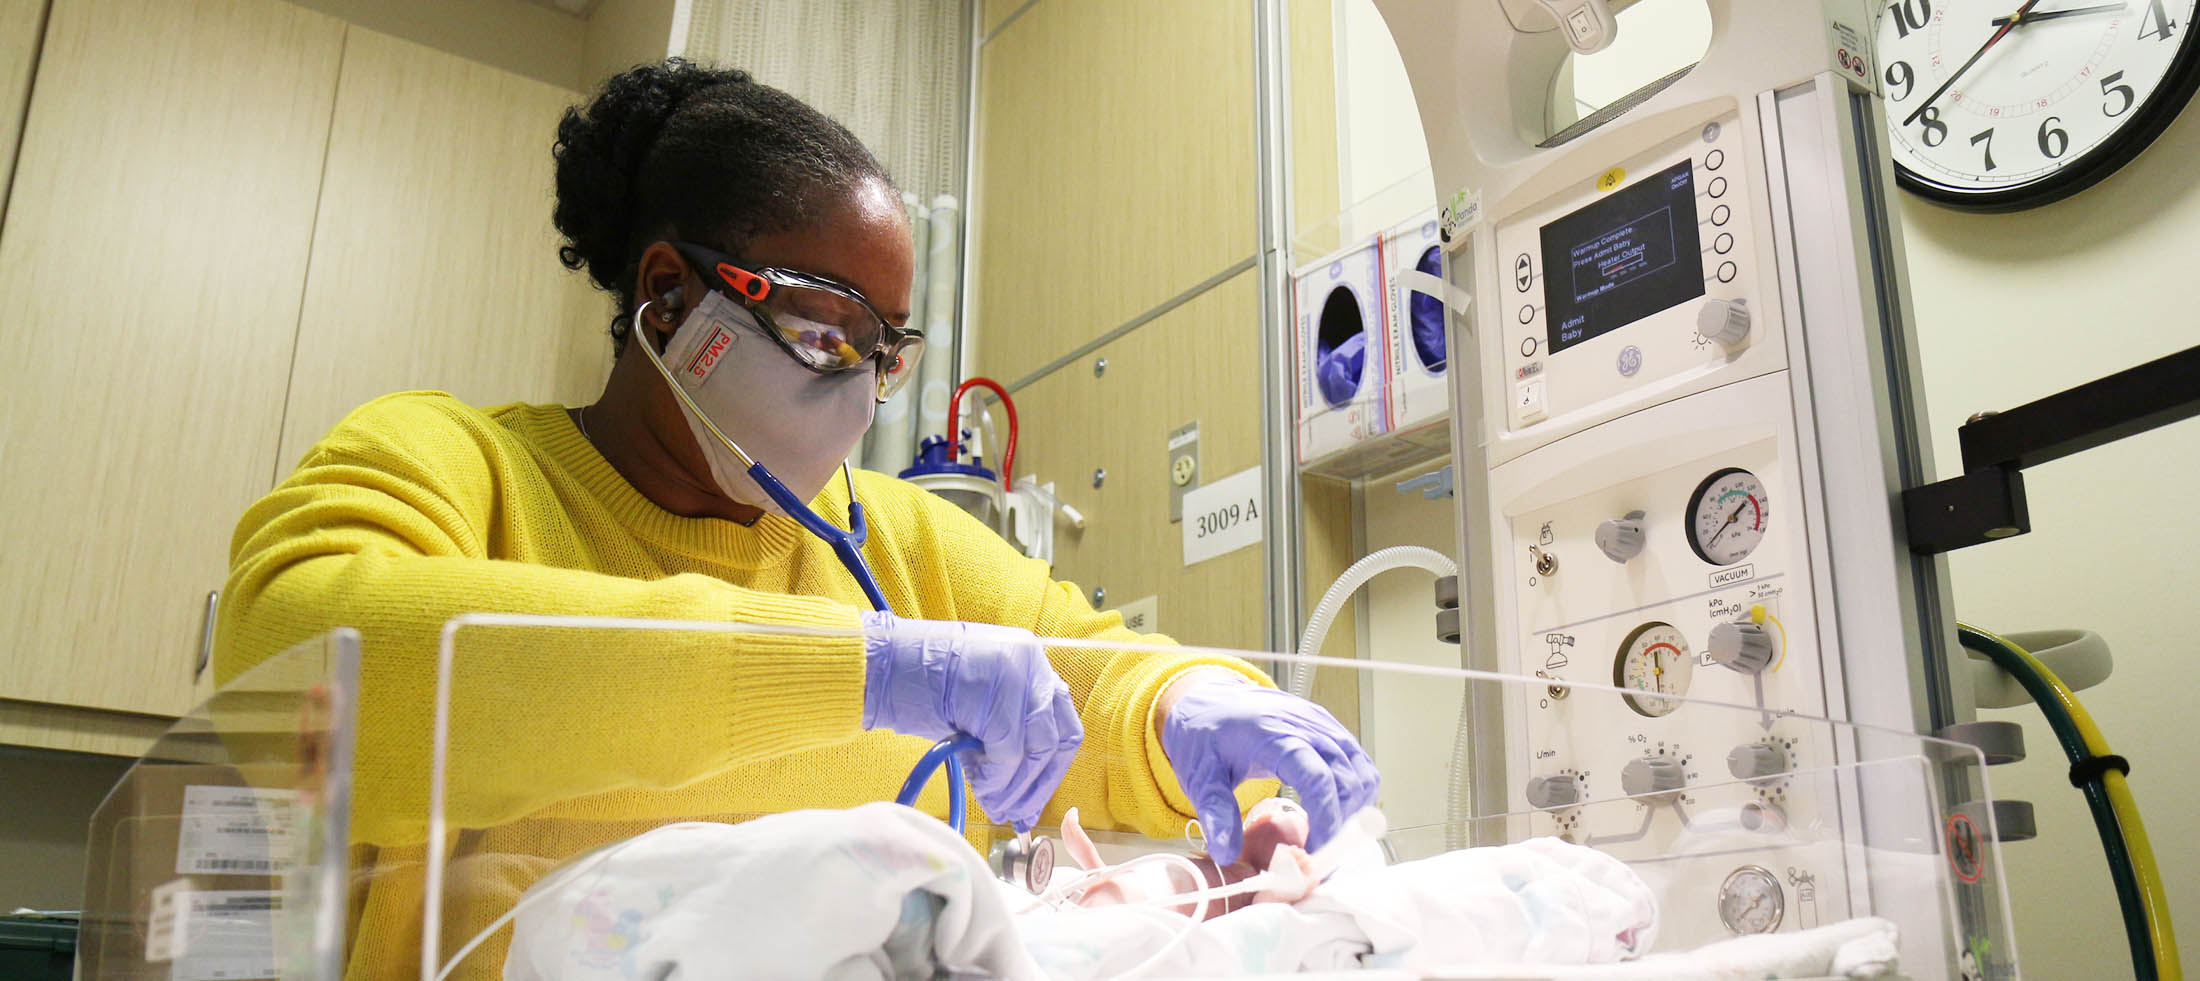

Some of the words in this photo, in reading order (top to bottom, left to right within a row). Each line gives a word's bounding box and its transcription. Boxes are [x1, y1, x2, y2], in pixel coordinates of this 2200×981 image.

[1888, 0, 1931, 39] 10
[2138, 0, 2177, 42] 4
[1885, 60, 1915, 102] 9
[2100, 70, 2135, 118] 5
[1988, 107, 2000, 117] 19
[2036, 99, 2048, 109] 18
[1919, 106, 1948, 147] 8
[2037, 116, 2069, 158] 6
[1970, 127, 1997, 172] 7
[1456, 202, 1477, 222] Panda
[1572, 241, 1600, 257] Warmup
[1601, 226, 1633, 245] Complete
[1572, 256, 1592, 266] Press
[1594, 246, 1612, 260] Admit
[1613, 239, 1631, 252] Baby
[1598, 254, 1620, 268] Heater
[1621, 244, 1645, 258] Output
[1561, 315, 1585, 330] Admit
[1561, 328, 1582, 342] Baby
[694, 332, 731, 379] PM2.5
[1197, 504, 1240, 539] 3009
[1246, 498, 1259, 521] A
[1714, 569, 1748, 584] VACUUM
[1709, 599, 1723, 609] kPa
[1125, 614, 1144, 629] USE
